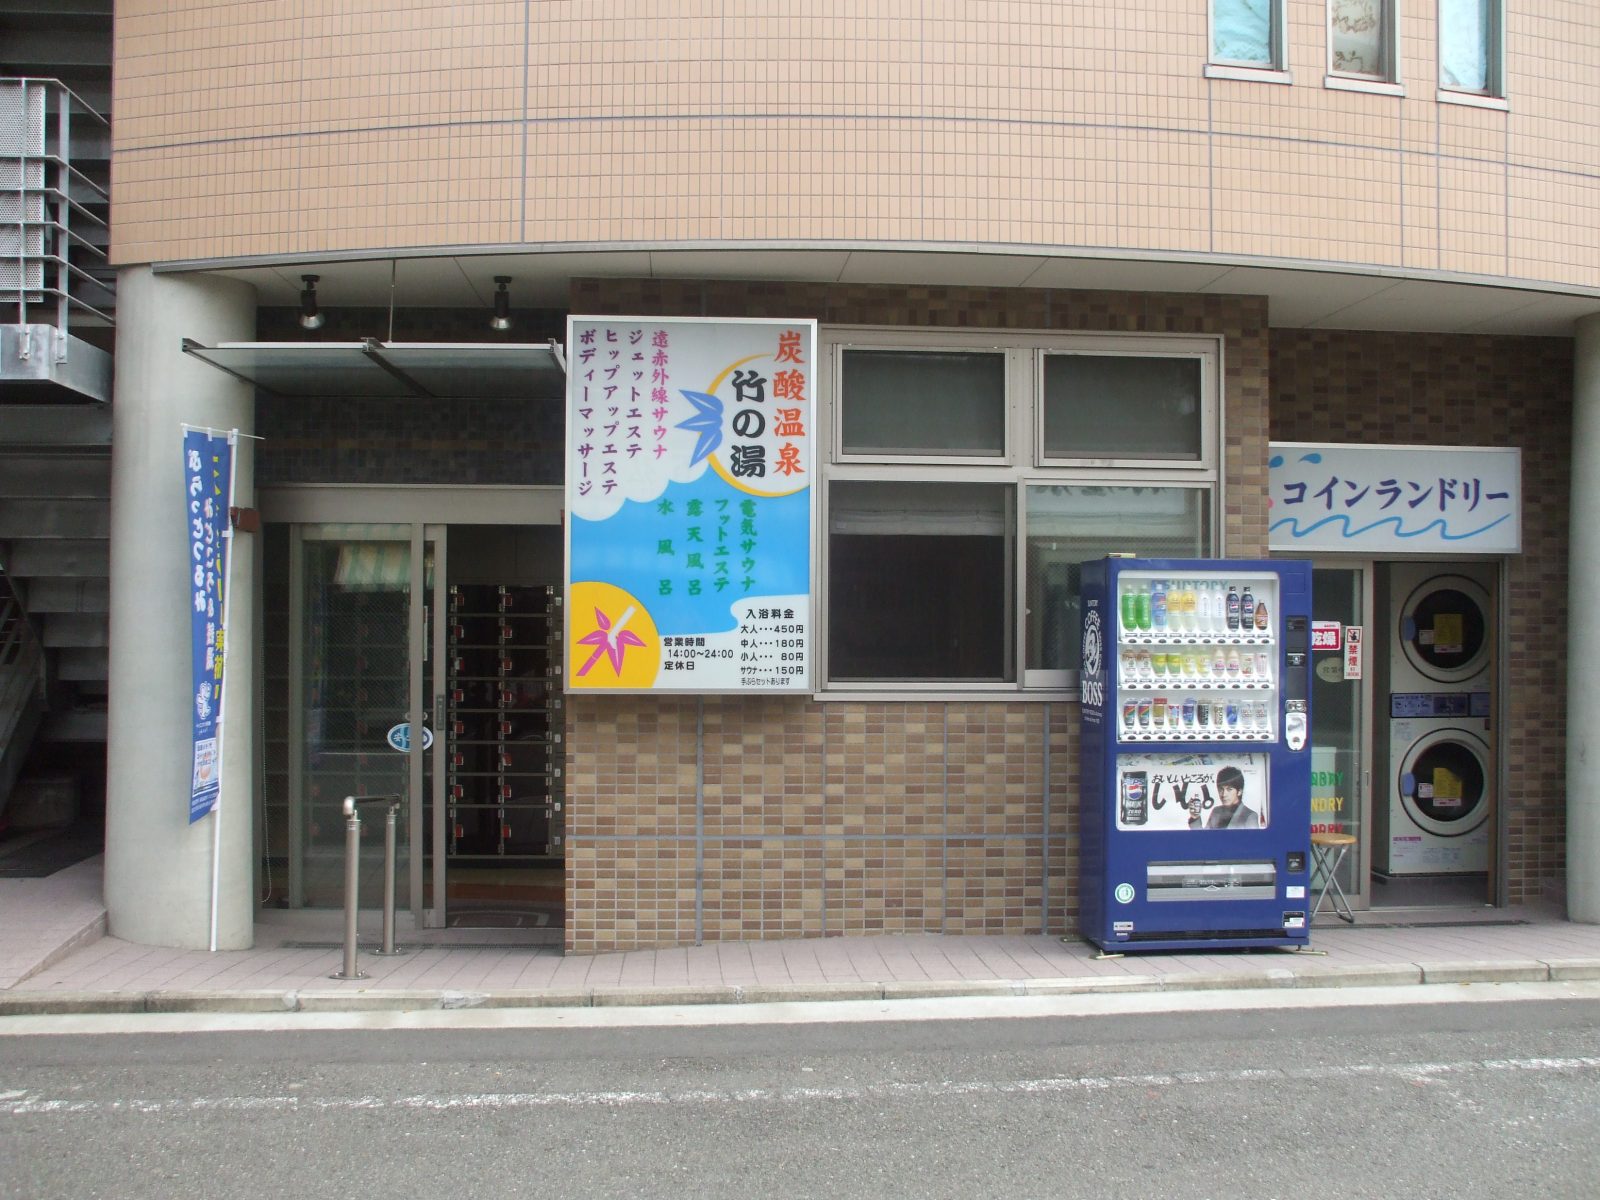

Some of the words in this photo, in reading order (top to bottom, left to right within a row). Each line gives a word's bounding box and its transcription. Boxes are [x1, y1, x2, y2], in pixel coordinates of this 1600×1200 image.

[577, 328, 596, 496] ボディーマッサージ
[602, 329, 620, 495] ヒップアップエステ
[626, 329, 644, 459] ジェットエステ
[651, 330, 670, 460] 遠赤外線サウナ
[730, 370, 766, 478] 竹の湯
[773, 330, 806, 478] 炭酸温泉
[1283, 476, 1510, 512] コインランドリー
[657, 498, 675, 595] 水風呂
[686, 498, 704, 596] 露天風呂
[713, 499, 731, 592] フットエステ
[739, 499, 758, 592] 電気サウナ
[663, 637, 705, 647] 営業時間
[746, 608, 795, 619] 入浴料金
[1084, 610, 1101, 630] COFFEE
[1348, 645, 1358, 667] 禁煙
[664, 661, 695, 671] 定休日
[1081, 680, 1103, 707] BOSS
